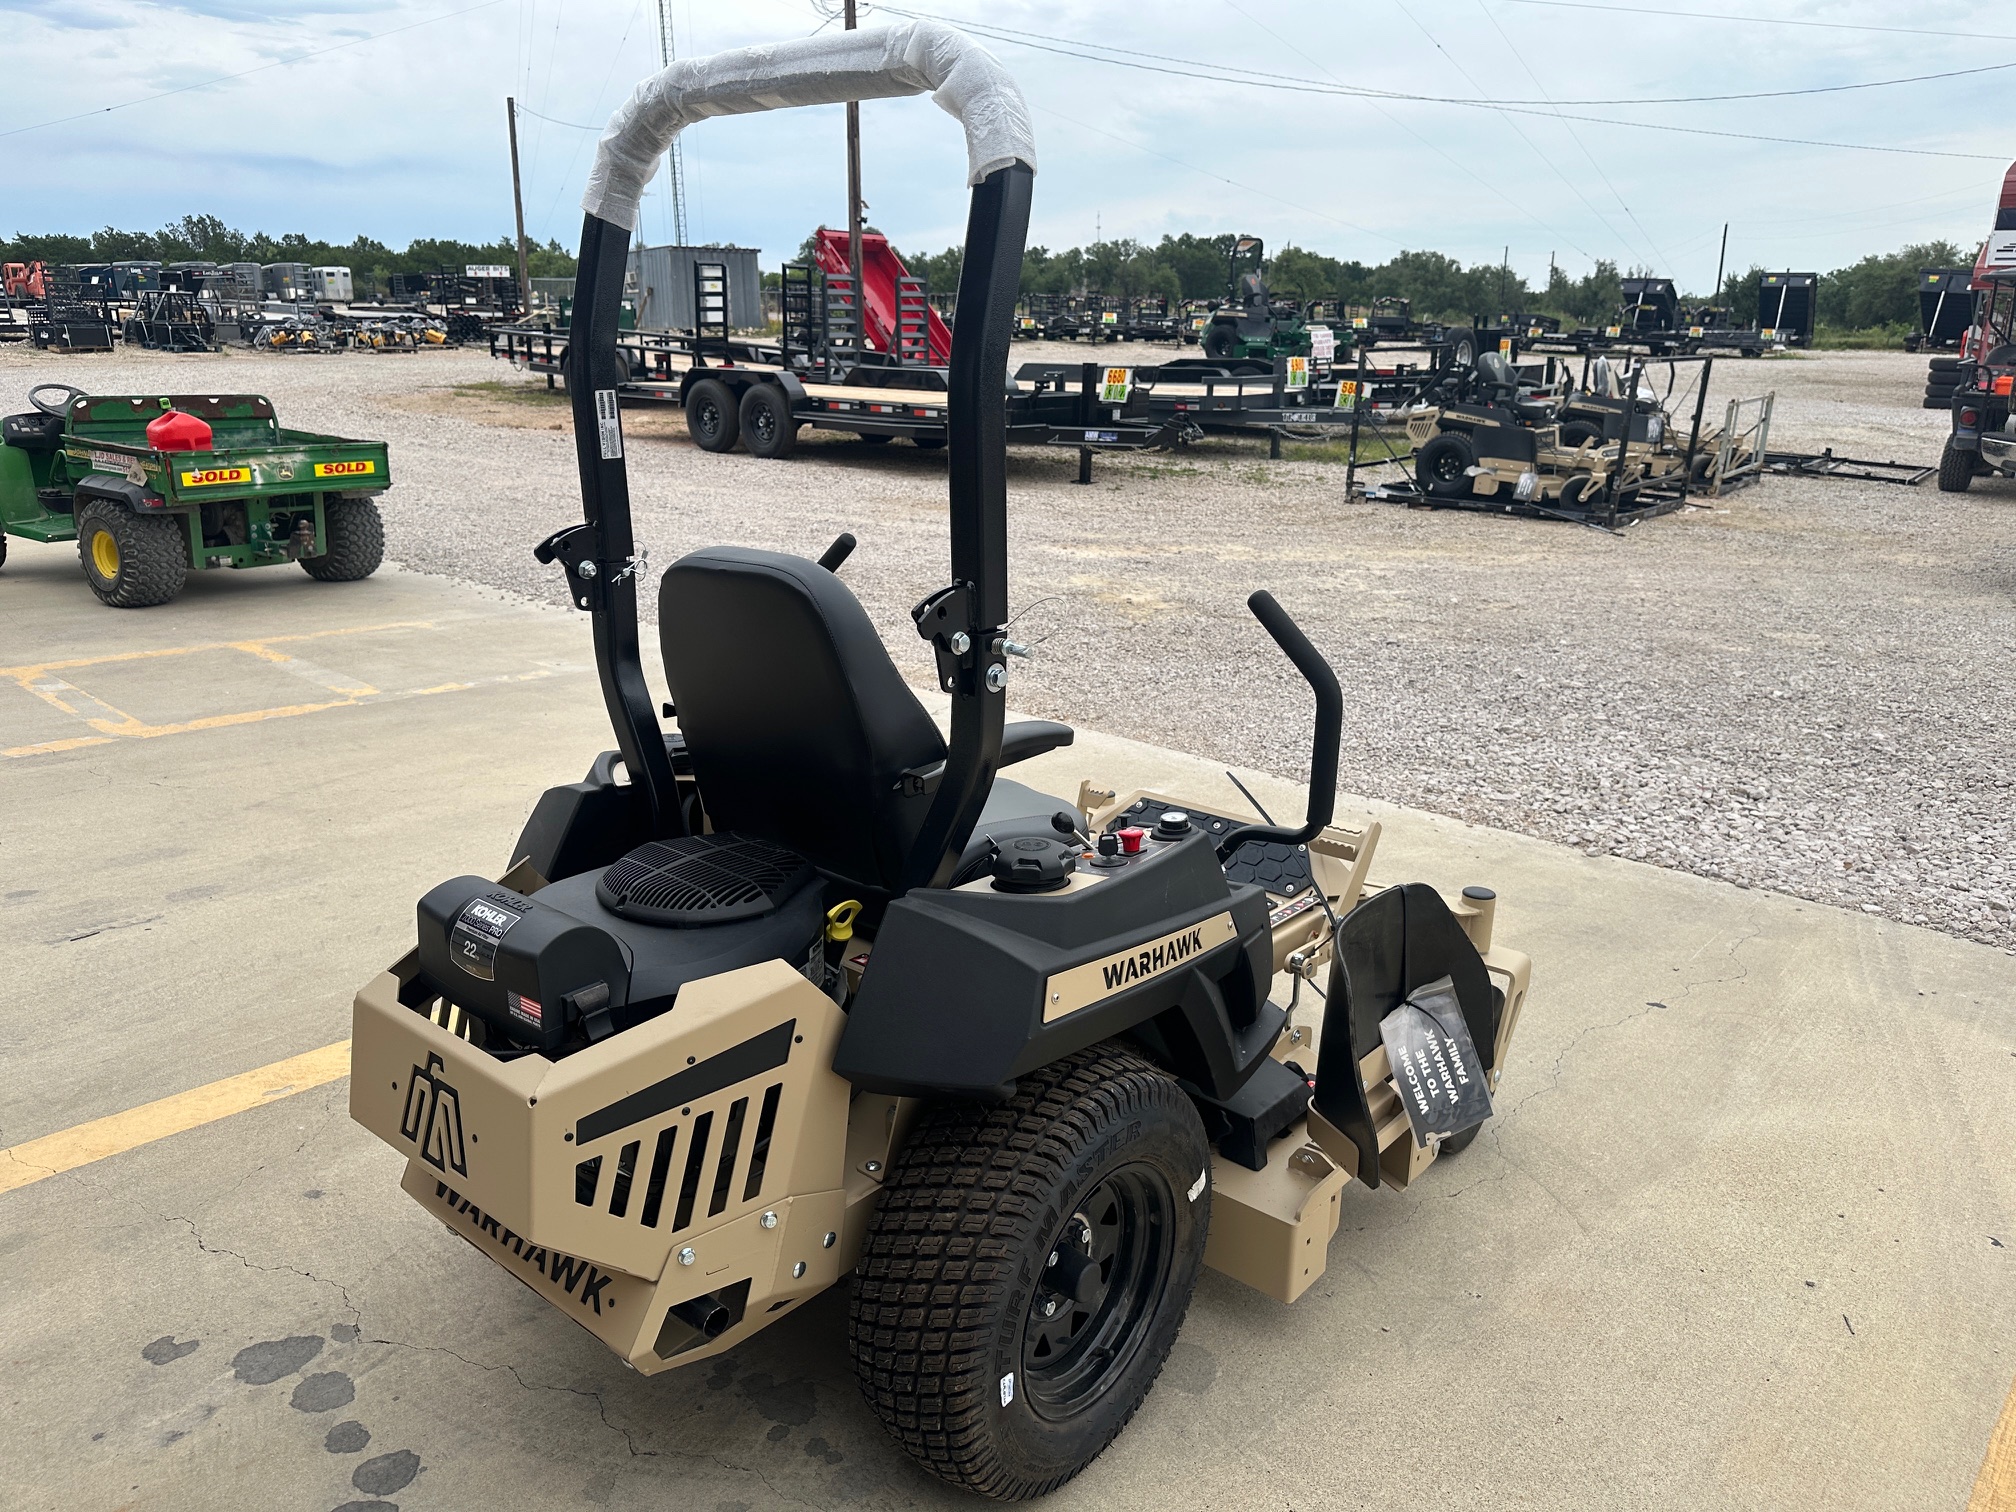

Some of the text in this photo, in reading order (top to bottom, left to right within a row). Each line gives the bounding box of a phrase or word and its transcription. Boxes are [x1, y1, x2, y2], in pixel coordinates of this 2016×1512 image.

[106, 453, 121, 462] SALES
[323, 463, 367, 475] SOLD
[191, 469, 241, 484] SOLD
[486, 891, 533, 914] KOHLER
[470, 904, 508, 927] KOHLER
[489, 925, 503, 937] PRO
[463, 940, 477, 958] 22
[1102, 927, 1202, 990] WARHAWK
[1424, 1028, 1460, 1105] WARHAWK
[1443, 1037, 1470, 1085] FAMILY
[1398, 1045, 1430, 1115] WELCOME
[1415, 1048, 1440, 1099] TO THE
[995, 1119, 1143, 1376] TURF MASTER
